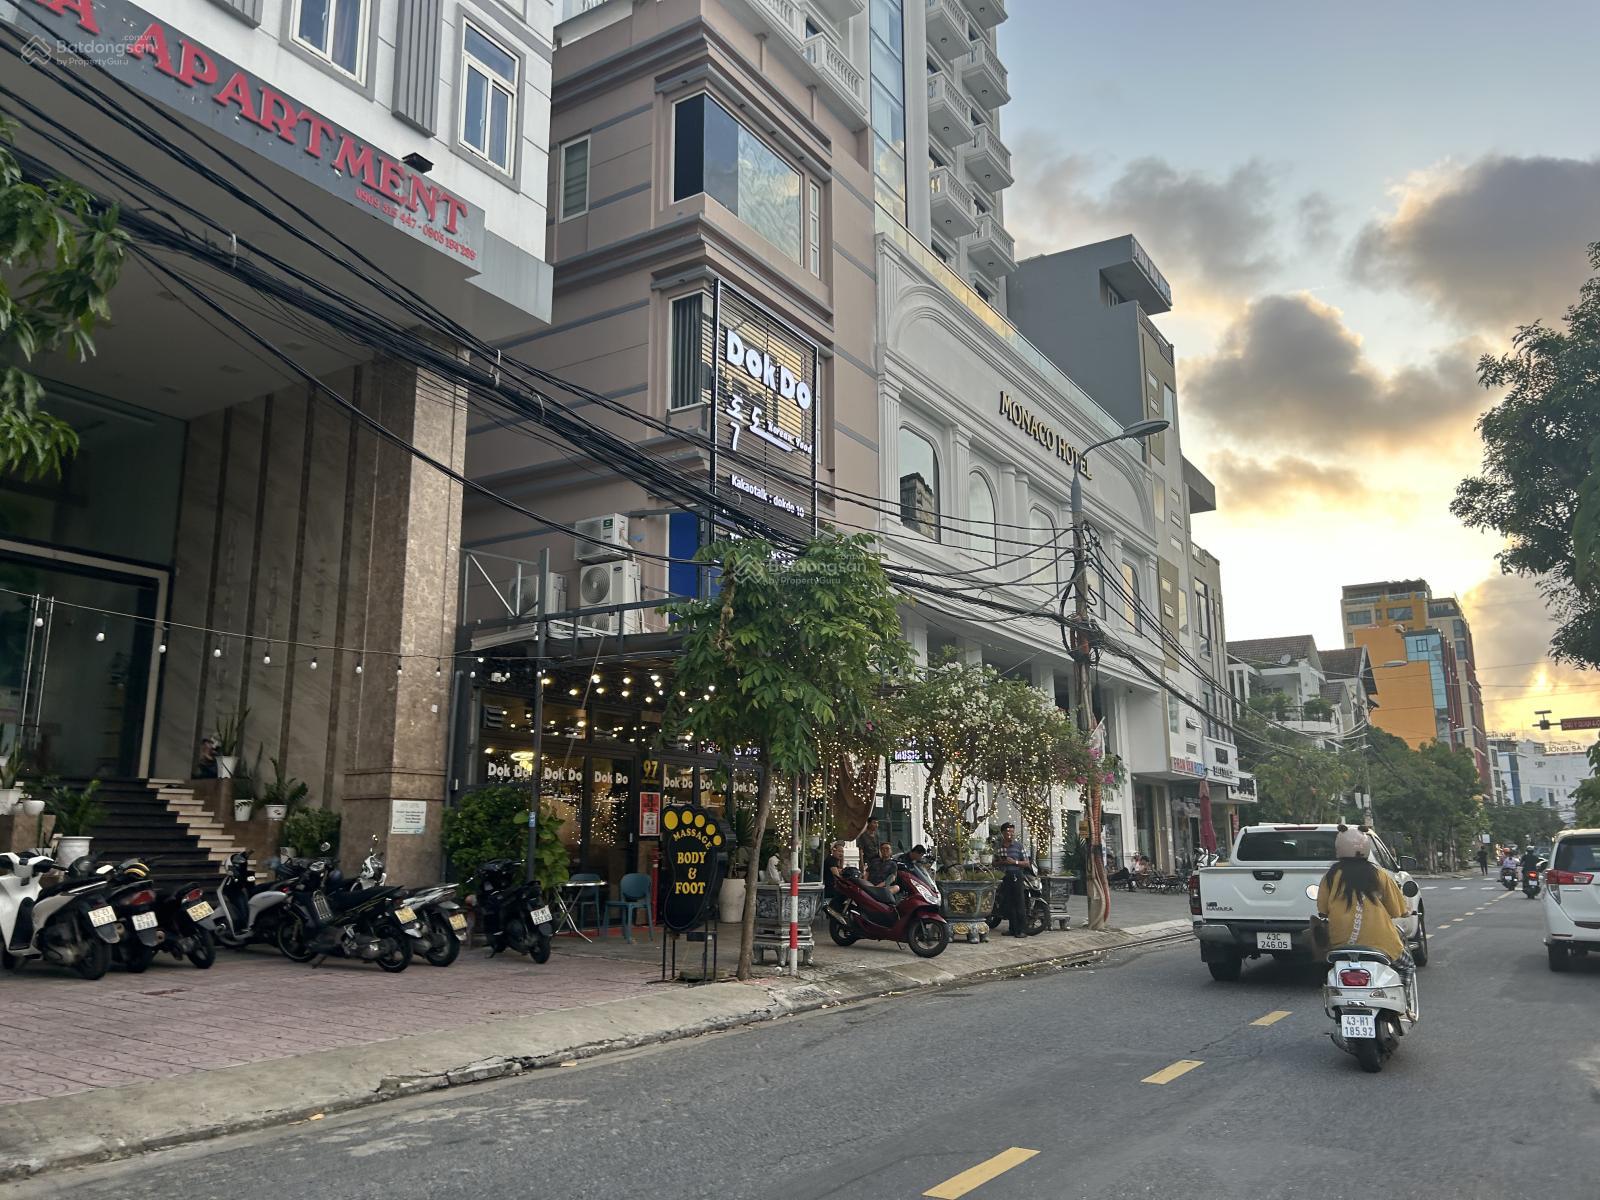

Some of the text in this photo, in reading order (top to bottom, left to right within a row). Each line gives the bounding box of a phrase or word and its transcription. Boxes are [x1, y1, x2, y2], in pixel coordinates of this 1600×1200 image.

[128, 22, 468, 234] APARTMENT
[999, 390, 1092, 481] MONACO HOTEL
[731, 474, 767, 501] Kakaotalk
[488, 762, 511, 777] Dok
[544, 767, 583, 781] Dok Do
[644, 761, 658, 779] 97
[594, 771, 629, 785] Dok Do
[664, 776, 694, 789] Dok Do
[733, 782, 748, 793] Dok
[749, 782, 759, 793] Do
[673, 828, 713, 850] MASSAGE
[677, 852, 706, 864] BODY
[688, 867, 697, 880] &
[675, 882, 706, 894] FOOT
[1267, 933, 1281, 941] 43C
[1261, 941, 1288, 949] 246.05
[1346, 1016, 1369, 1026] 43-H1
[1345, 1026, 1374, 1037] 185.92
